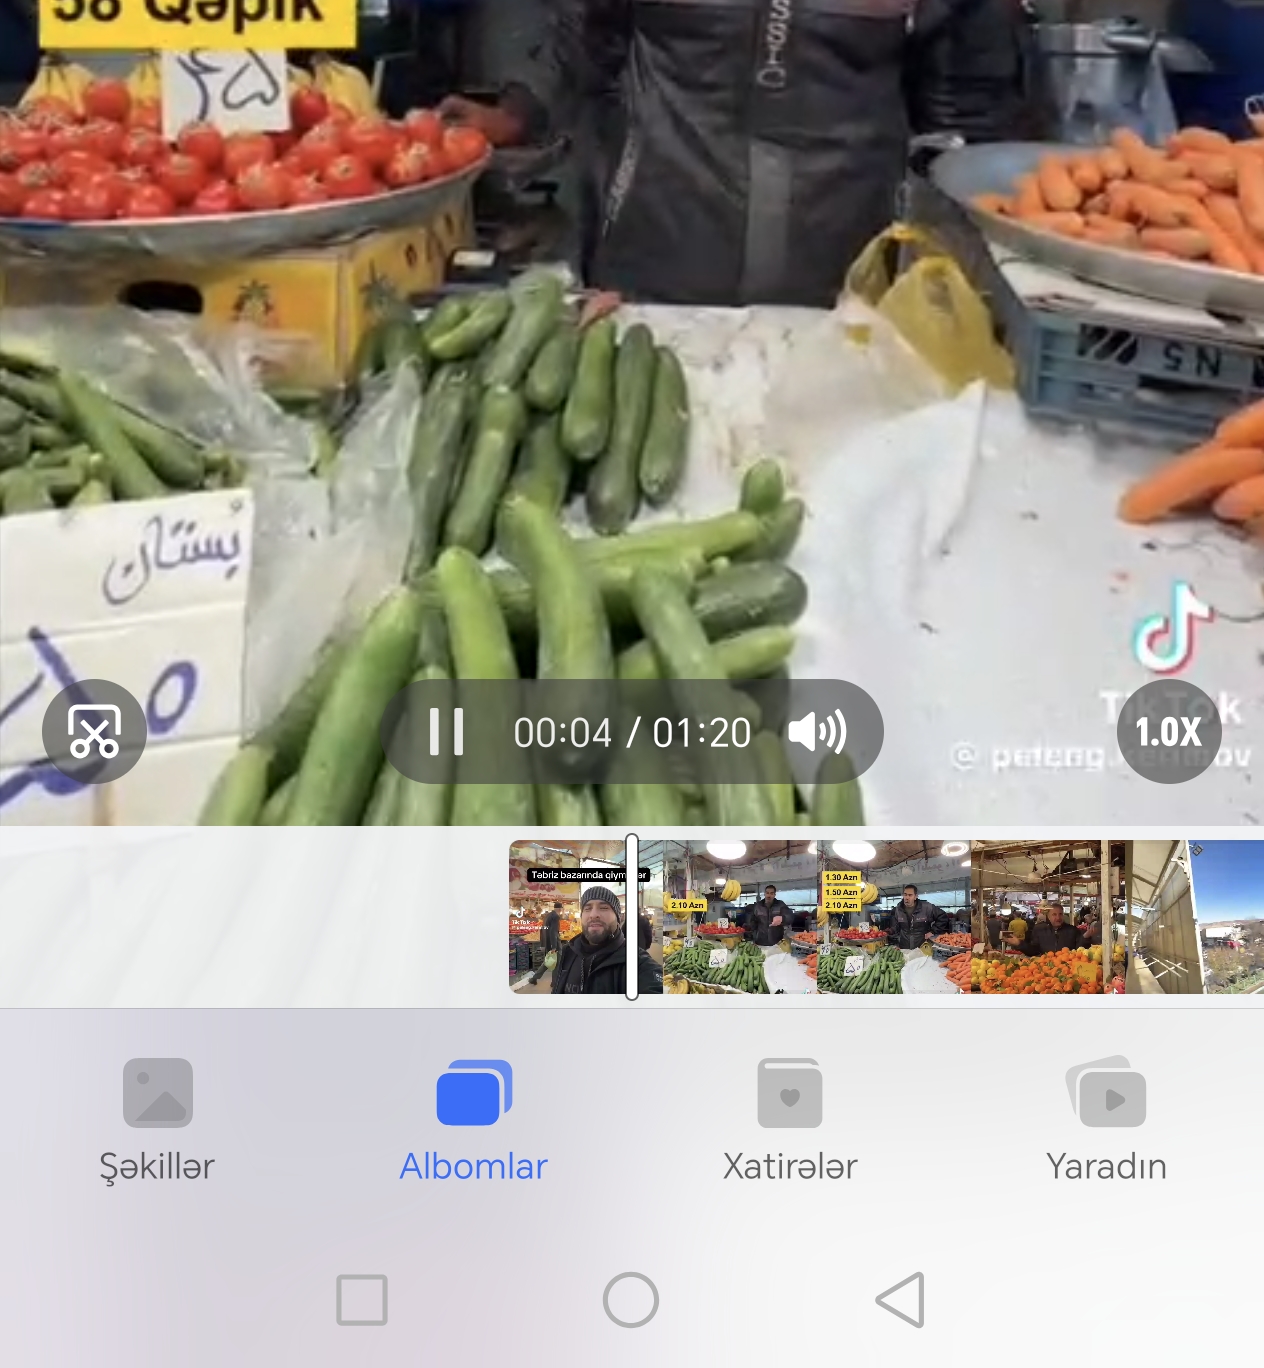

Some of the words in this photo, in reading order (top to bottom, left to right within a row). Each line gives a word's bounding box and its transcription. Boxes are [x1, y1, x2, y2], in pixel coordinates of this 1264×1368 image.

[514, 717, 612, 748] 00:04
[653, 717, 751, 748] 01:20
[1136, 716, 1203, 747] 1.0X
[99, 1151, 216, 1188] Şəkillər
[399, 1151, 549, 1180] Albomlar
[722, 1151, 859, 1180] Xatirələr
[1045, 1151, 1166, 1180] Yaradın
